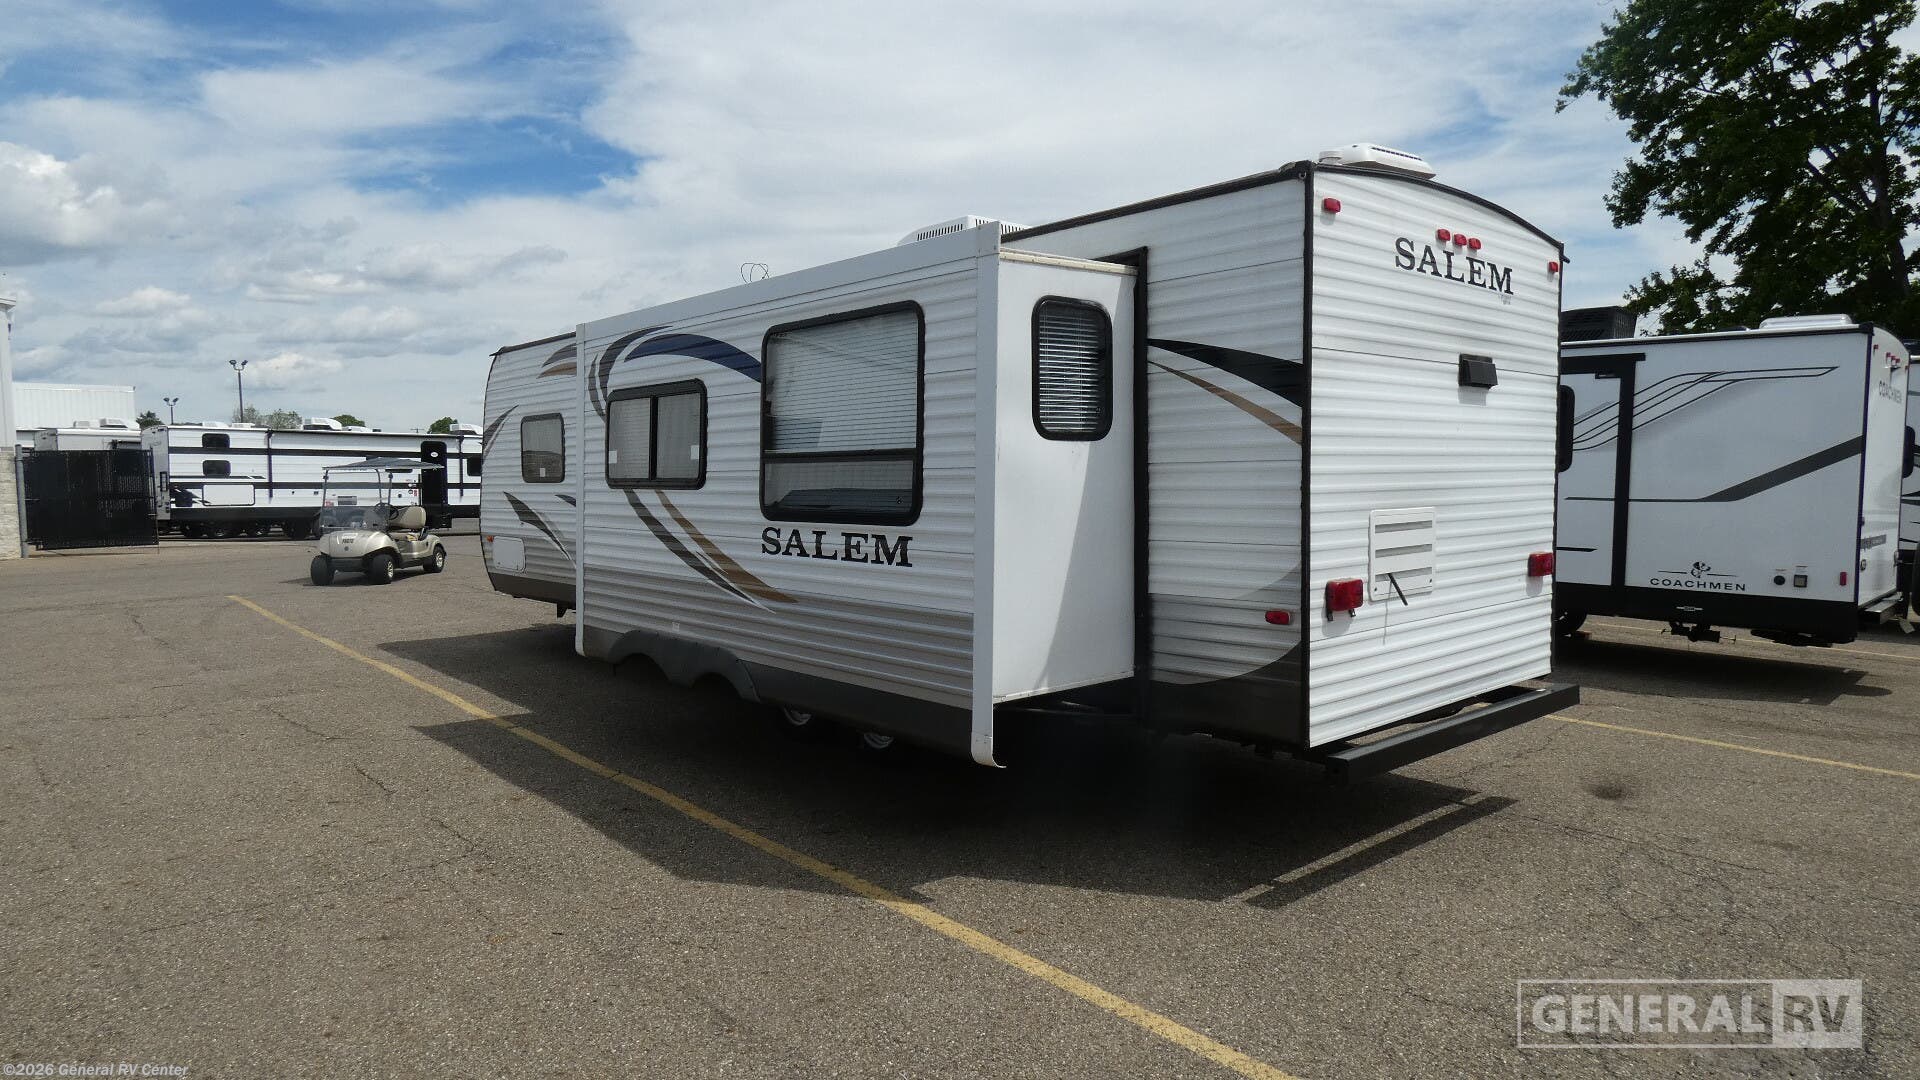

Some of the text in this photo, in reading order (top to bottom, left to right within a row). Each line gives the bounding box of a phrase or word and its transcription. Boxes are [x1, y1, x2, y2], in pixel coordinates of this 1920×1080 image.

[1395, 237, 1514, 295] SALEM
[761, 526, 913, 567] SALEM
[1650, 578, 1746, 591] COACHMEN
